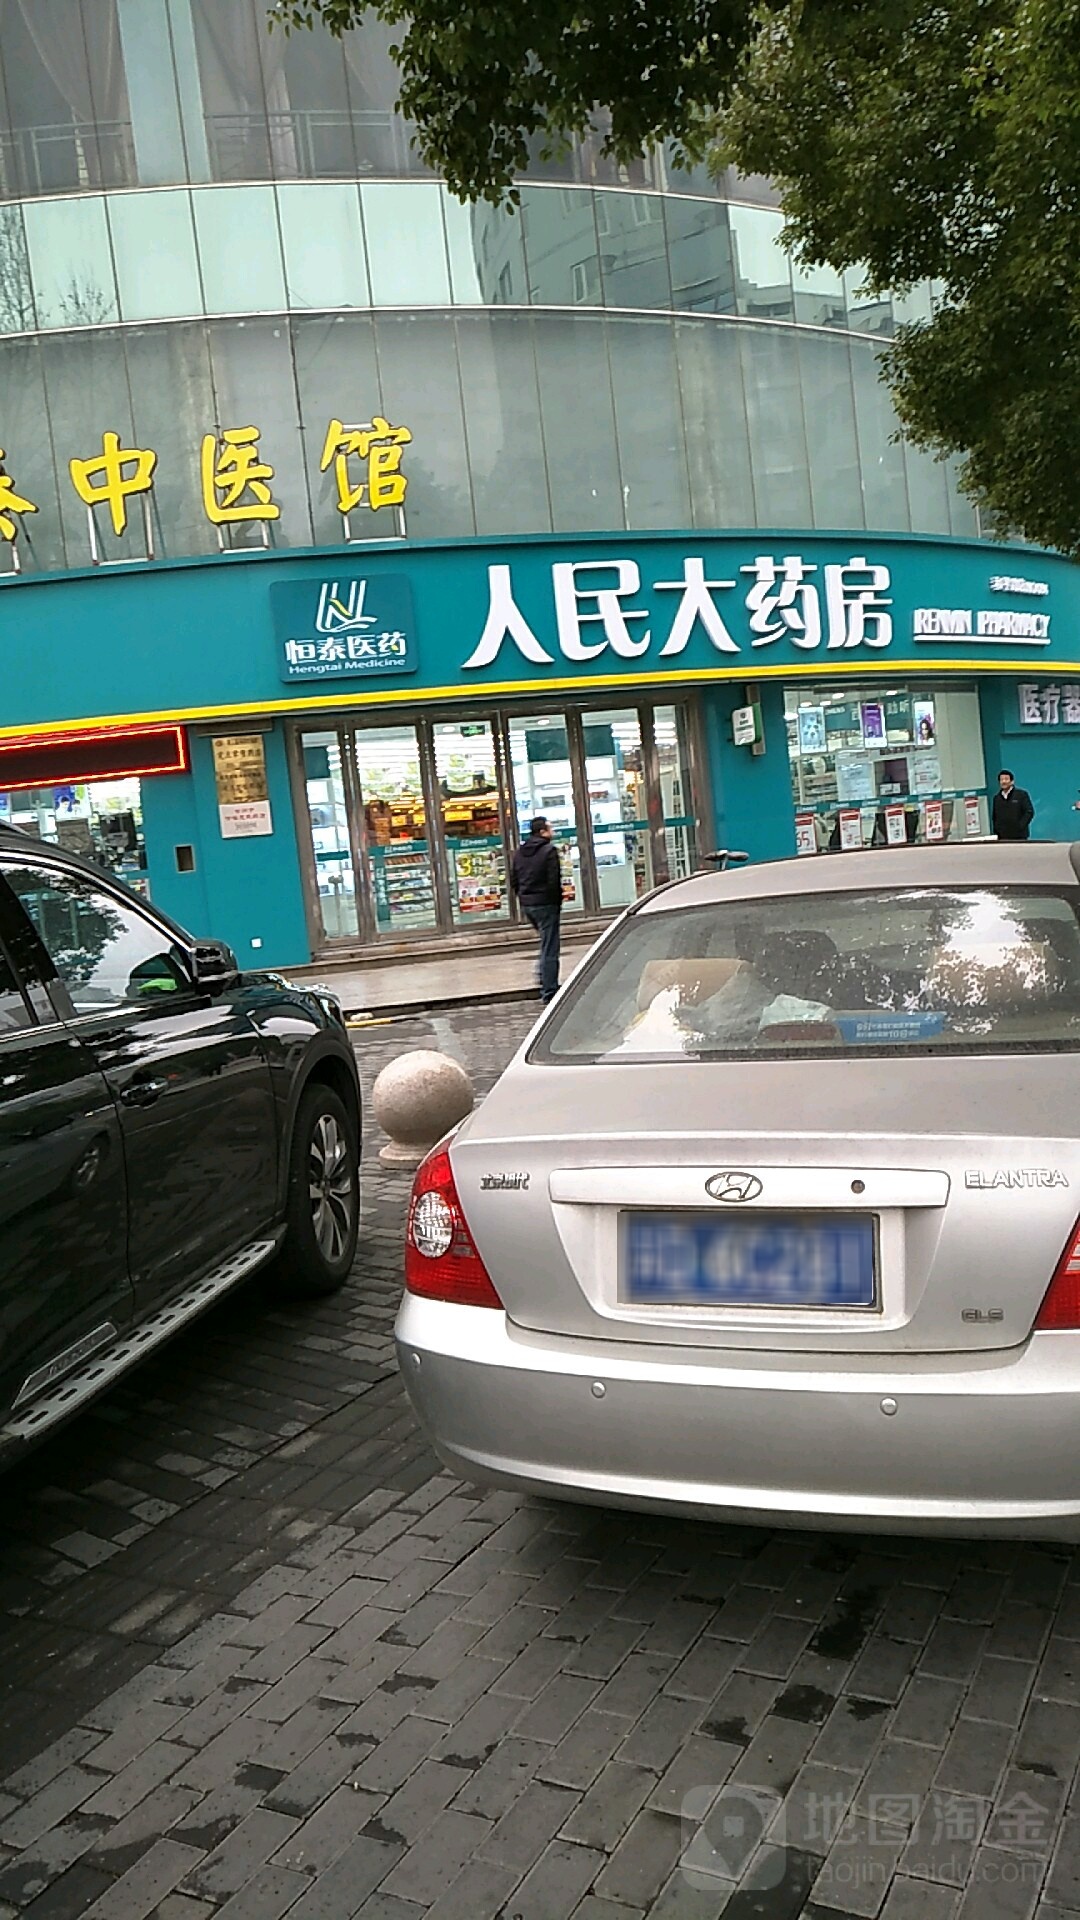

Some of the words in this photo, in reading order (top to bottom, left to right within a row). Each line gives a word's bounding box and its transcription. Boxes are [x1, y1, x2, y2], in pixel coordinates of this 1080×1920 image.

[461, 555, 894, 669] 人民大药房
[914, 608, 973, 635] RENMIN
[977, 610, 1052, 638] PHARMACY
[285, 631, 406, 665] 恒泰医药
[288, 661, 342, 677] Hengtai
[344, 657, 406, 671] Medicine
[964, 1168, 1070, 1189] ELANTRA
